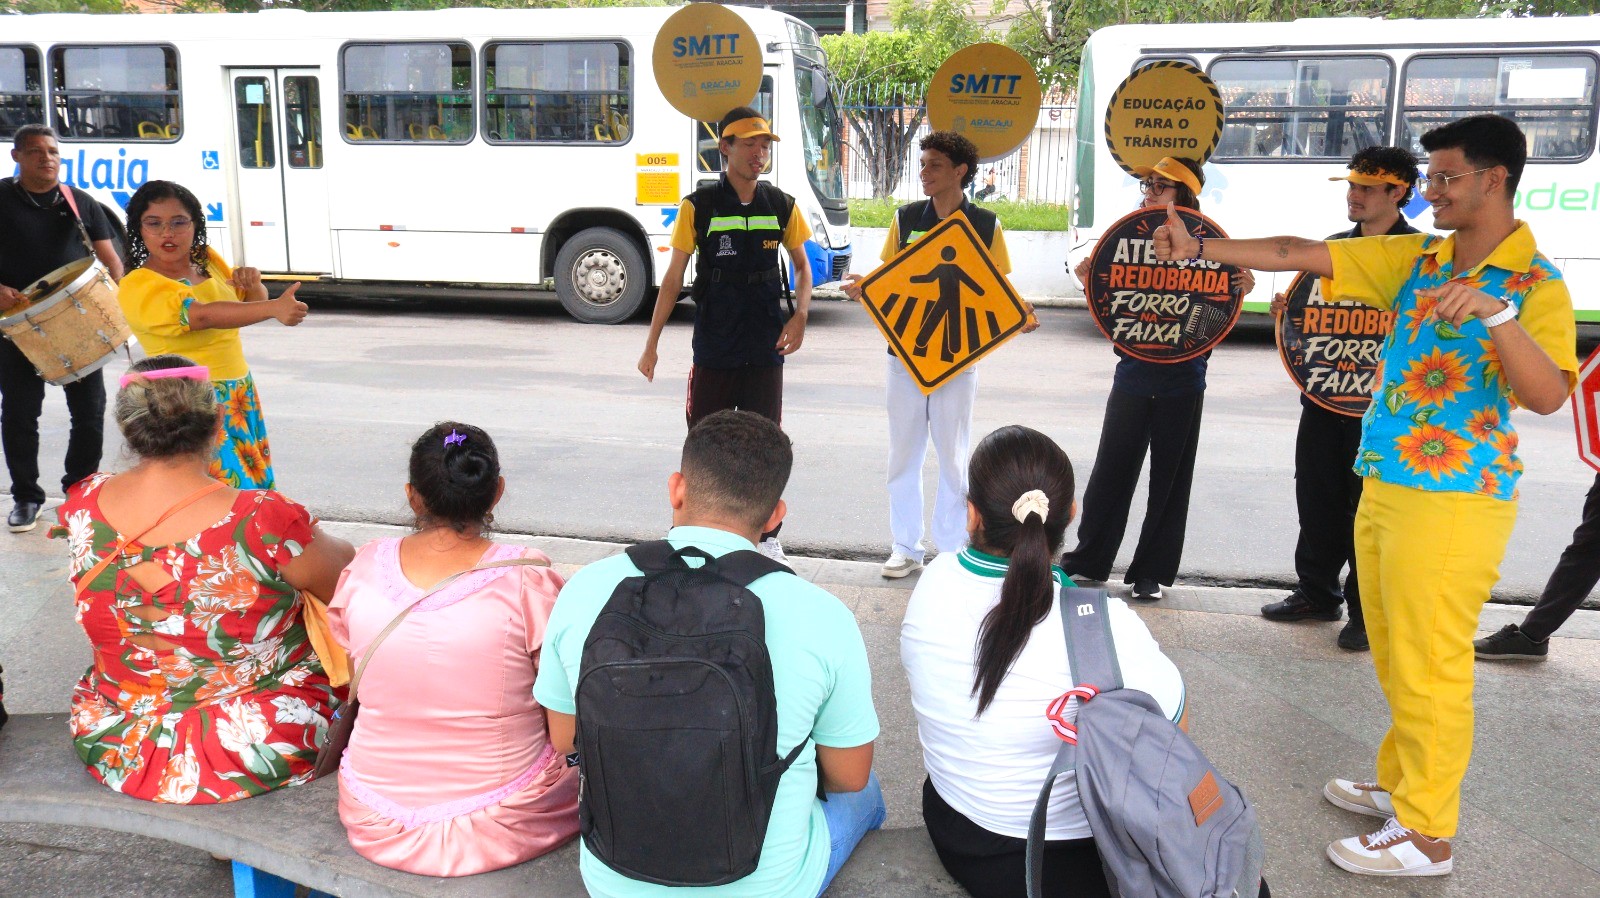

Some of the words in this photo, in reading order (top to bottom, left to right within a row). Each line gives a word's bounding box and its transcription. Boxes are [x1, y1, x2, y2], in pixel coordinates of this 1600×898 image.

[673, 33, 740, 58] SMTT
[700, 80, 741, 90] ARACAJU
[950, 73, 1022, 95] SMTT
[1123, 96, 1206, 113] EDUCAÇÃO
[970, 118, 1013, 128] ARACAJU
[1134, 117, 1174, 129] PARA
[1178, 118, 1189, 130] O
[1123, 135, 1198, 149] TRÂNSITO
[647, 156, 667, 165] 005
[1109, 264, 1229, 295] REDOBRADA
[1110, 290, 1190, 317] FORRÓ
[1140, 312, 1158, 323] NA
[1302, 307, 1392, 335] REDOBR
[1112, 317, 1182, 345] FAIXA
[1336, 360, 1357, 373] NA
